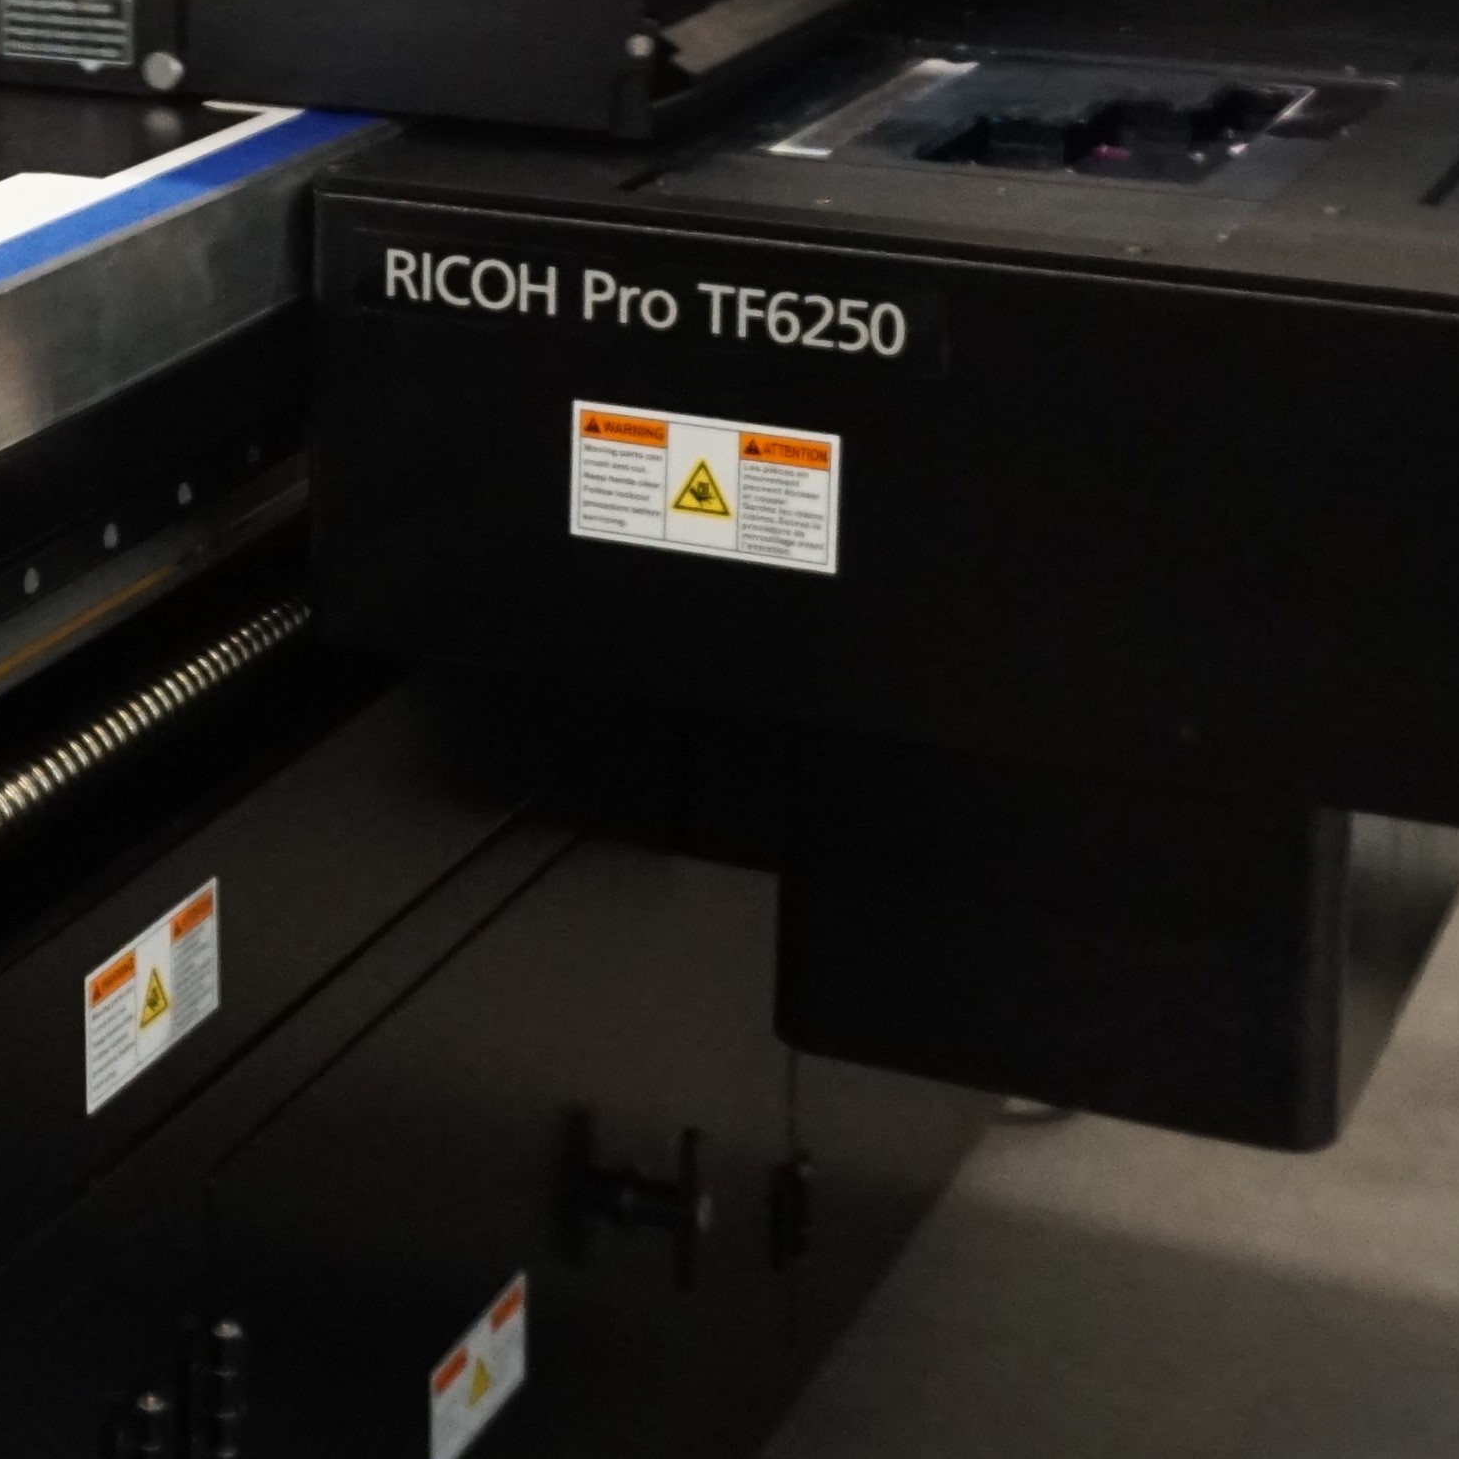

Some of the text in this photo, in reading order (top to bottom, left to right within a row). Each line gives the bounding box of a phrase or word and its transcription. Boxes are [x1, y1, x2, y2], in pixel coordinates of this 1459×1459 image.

[384, 248, 907, 358] RICOH Pro TF6250
[603, 421, 665, 440] WARNING
[763, 442, 828, 462] ATTENTION
